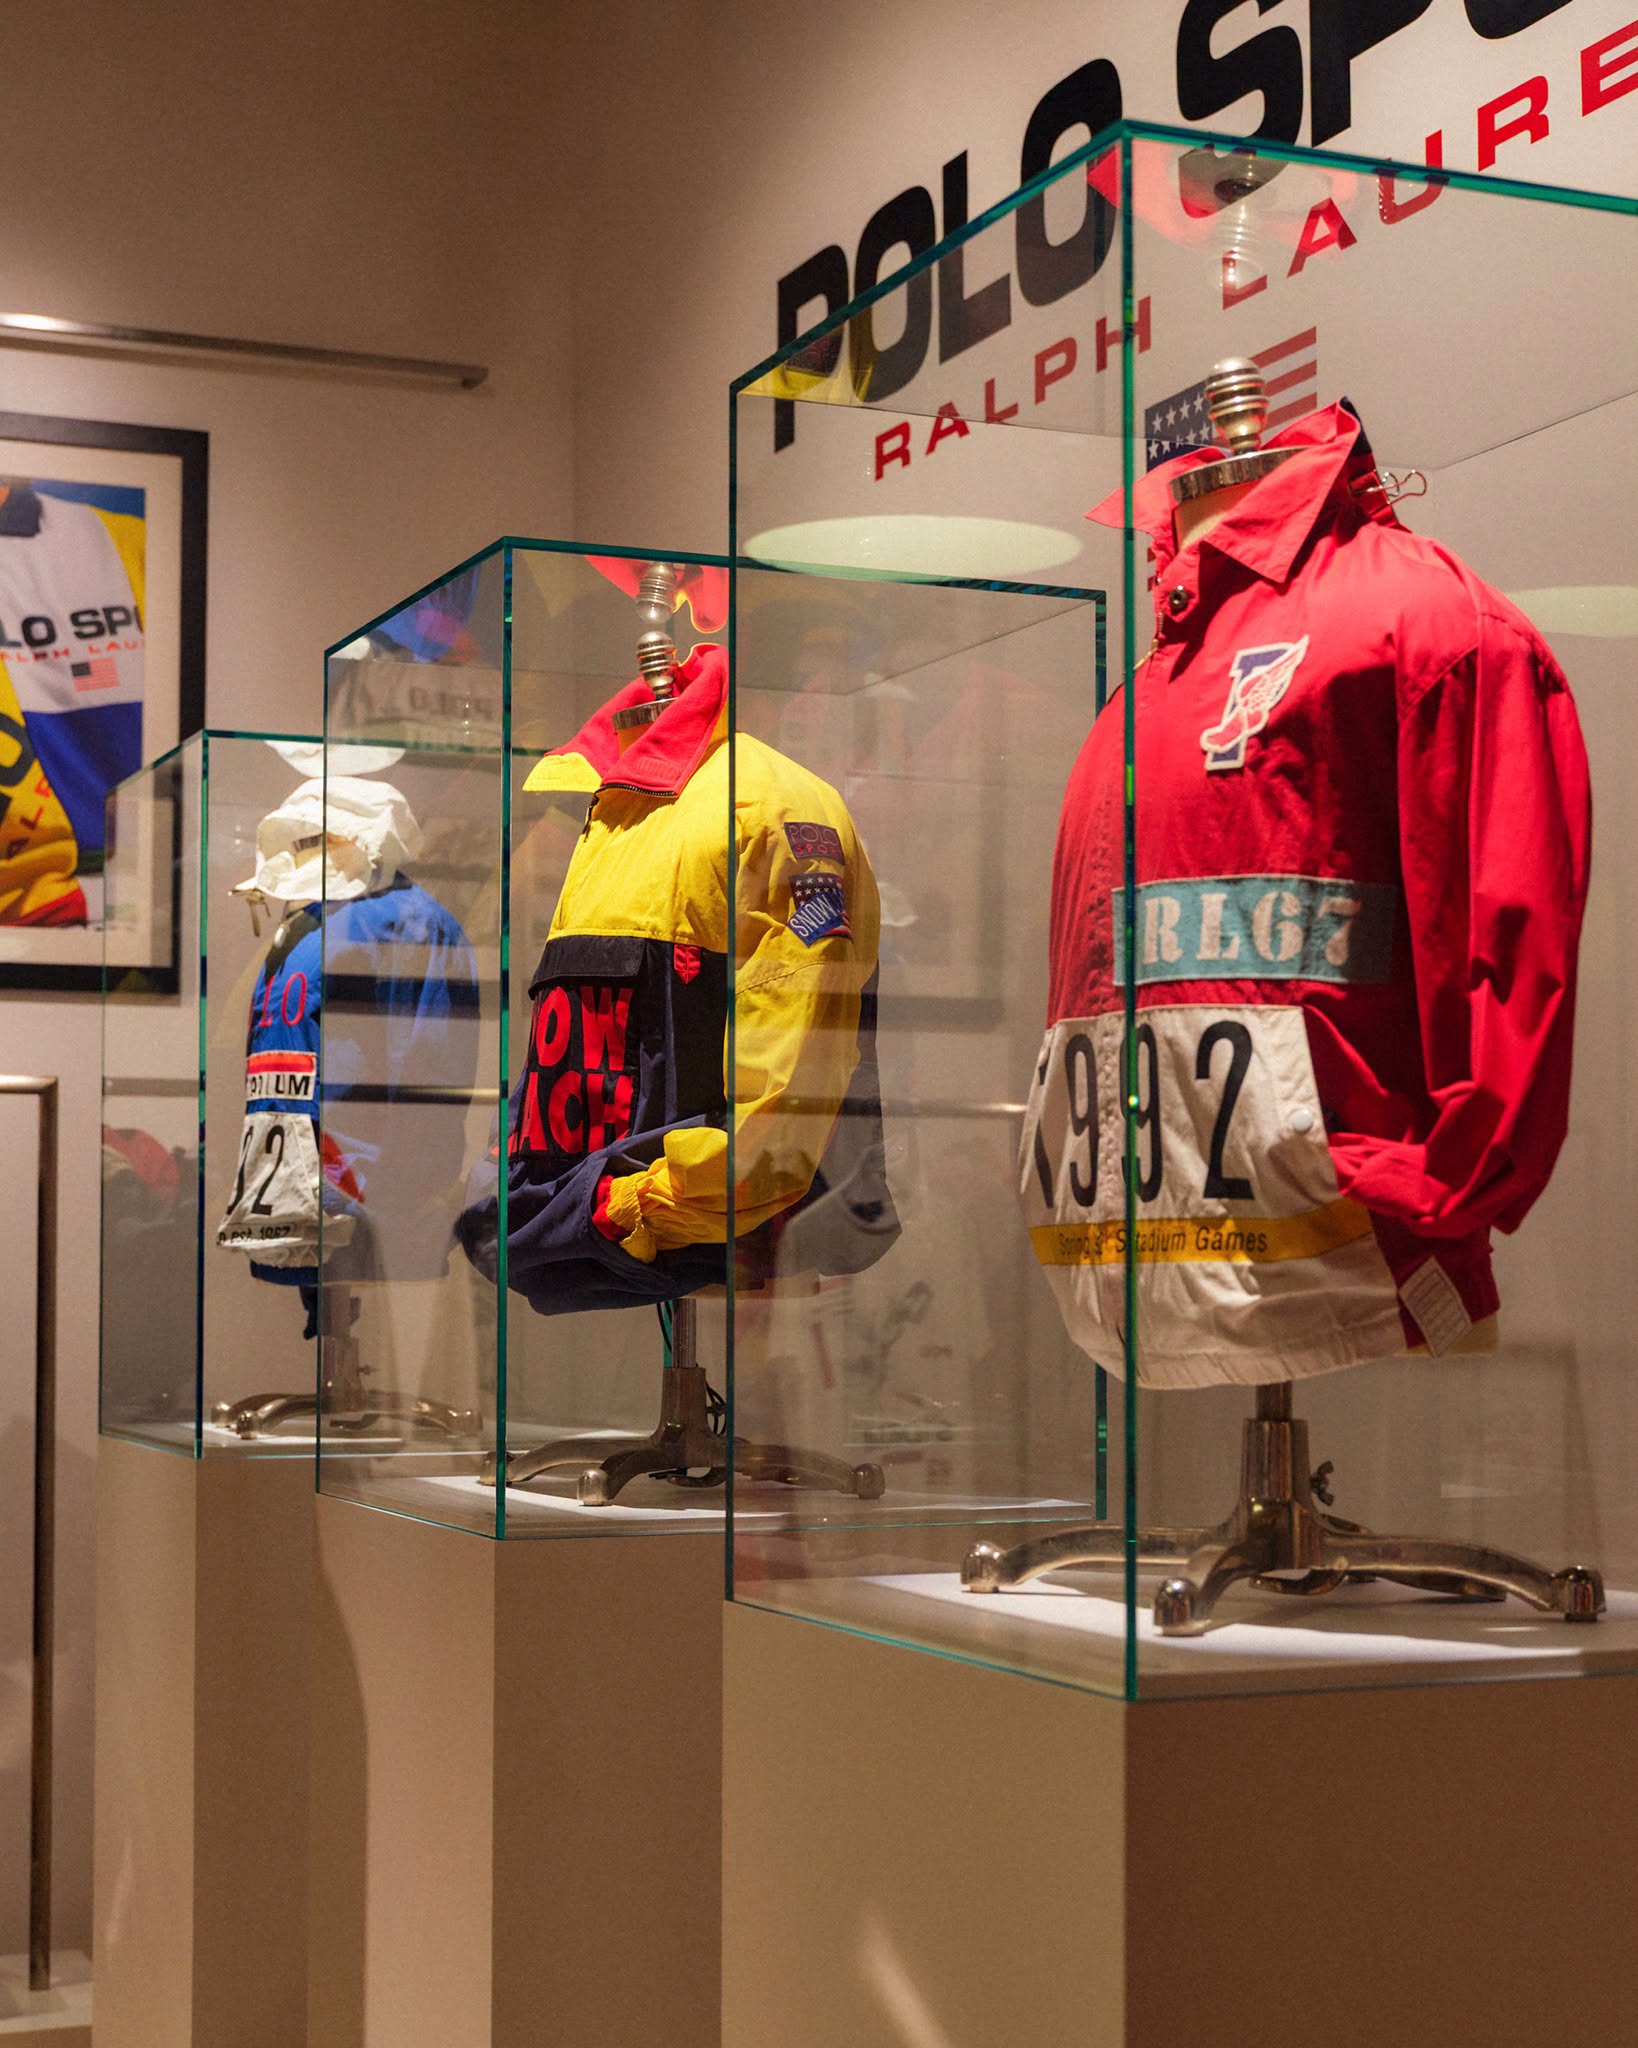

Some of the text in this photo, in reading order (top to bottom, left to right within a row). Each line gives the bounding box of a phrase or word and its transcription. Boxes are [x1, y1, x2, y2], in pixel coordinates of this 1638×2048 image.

[774, 59, 1124, 453] POLO
[874, 296, 1151, 481] RALPH
[87, 641, 145, 655] LAU
[789, 824, 839, 846] POLO
[789, 894, 838, 937] SNOW
[1142, 889, 1364, 967] RL67
[247, 972, 308, 1029] LO
[530, 986, 633, 1070] OW
[508, 1070, 634, 1158] ACH
[1195, 1226, 1268, 1252] Games
